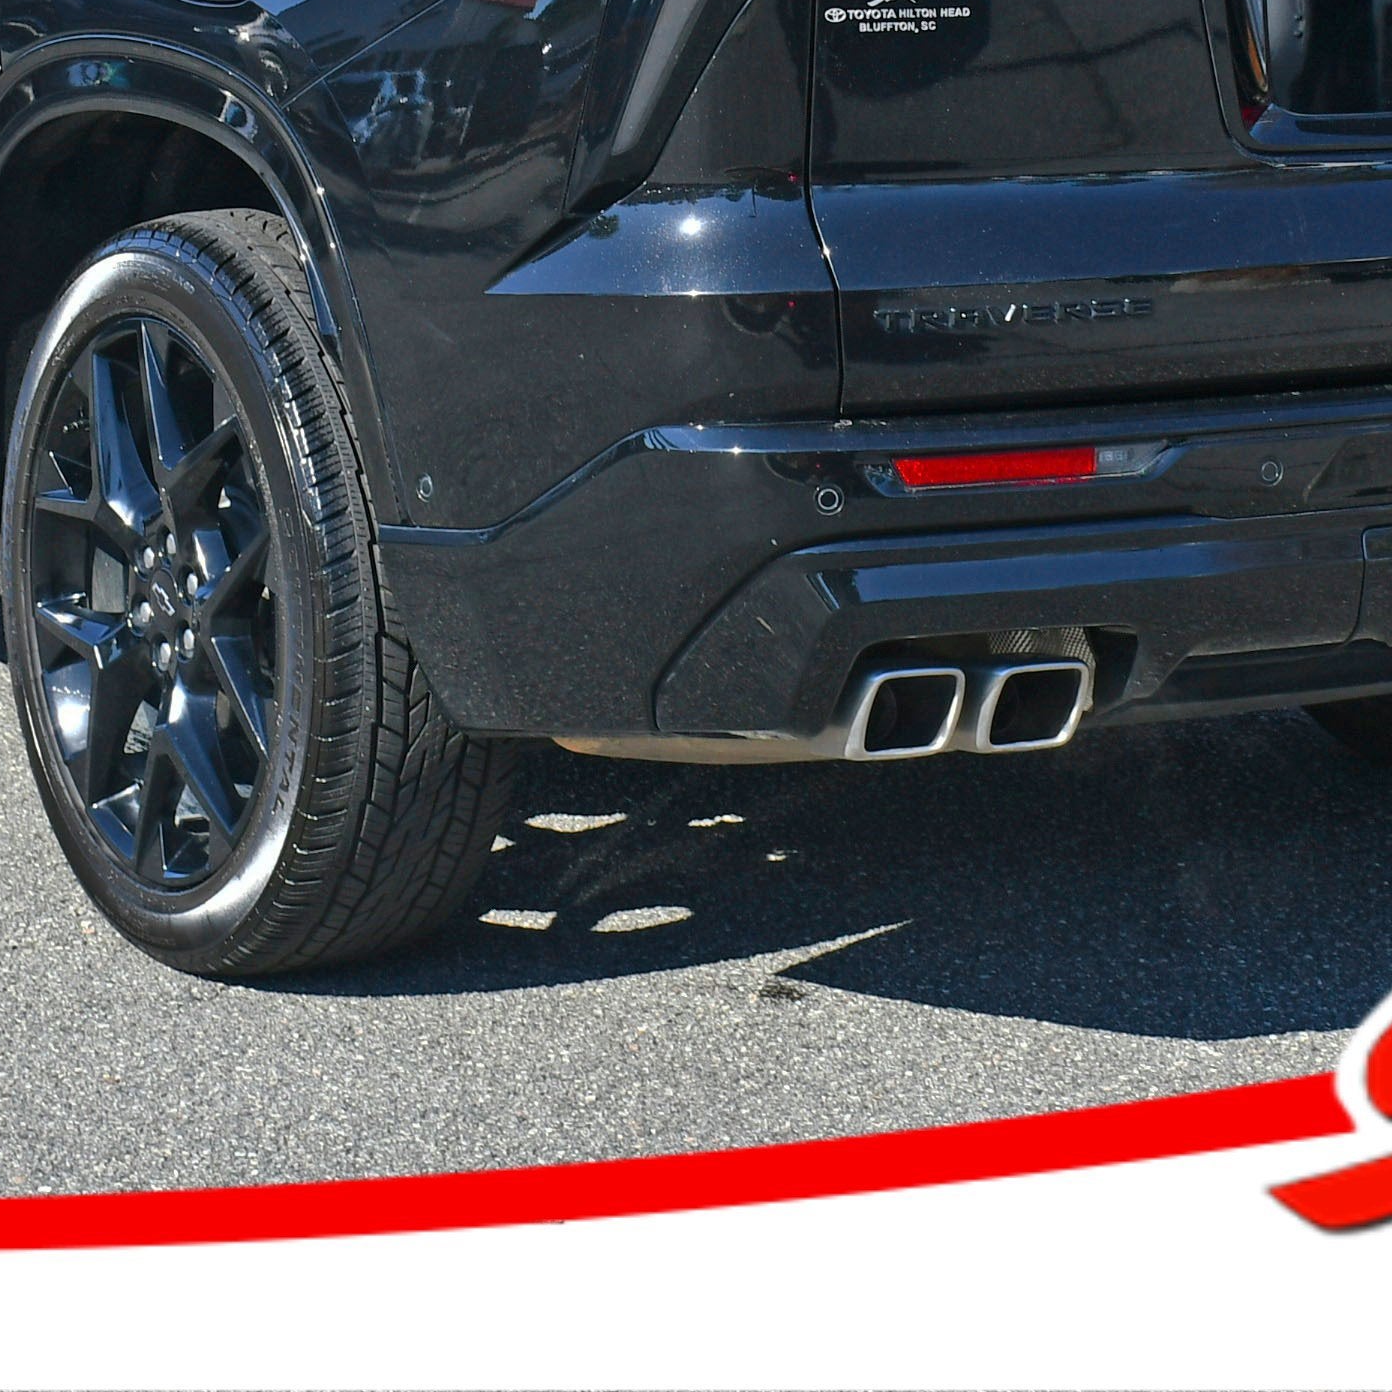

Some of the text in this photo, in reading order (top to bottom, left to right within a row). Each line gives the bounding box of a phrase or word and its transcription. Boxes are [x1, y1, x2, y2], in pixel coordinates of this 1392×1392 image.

[847, 7, 971, 20] TOYOTA HILTON HEAD
[859, 20, 937, 33] BLUFFTON, SC
[873, 298, 1153, 334] TRAVERSE
